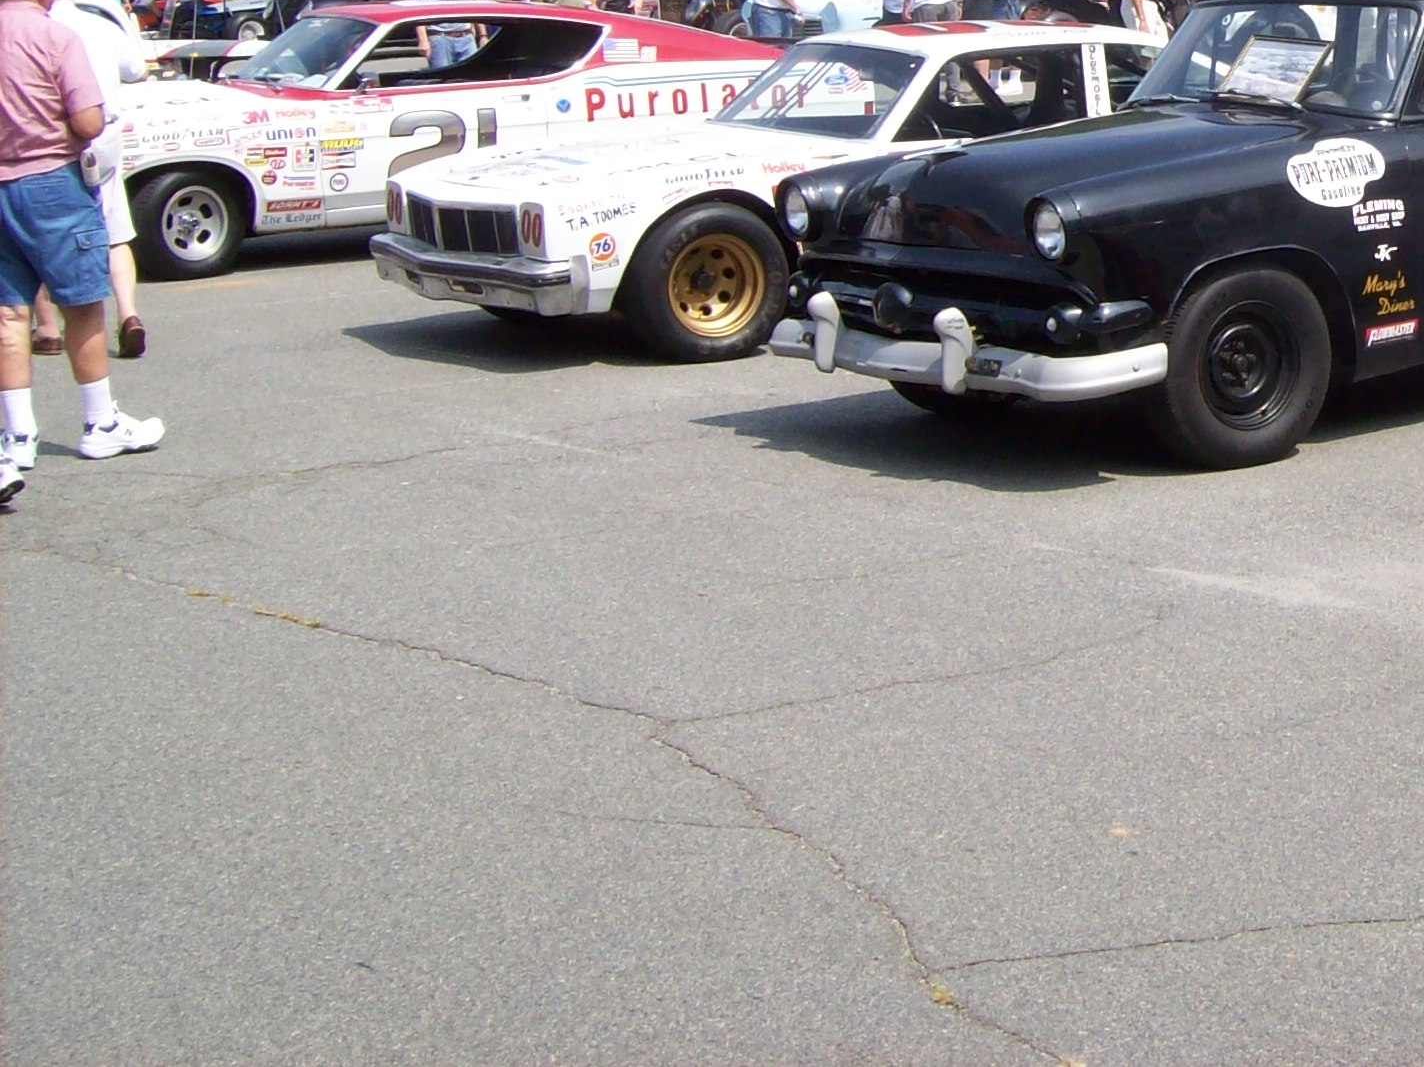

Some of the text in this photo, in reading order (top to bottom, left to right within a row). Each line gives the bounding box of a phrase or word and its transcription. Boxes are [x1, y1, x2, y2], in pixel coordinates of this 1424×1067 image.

[1088, 44, 1101, 116] OLDSMOBIL
[584, 79, 807, 122] Purolator
[242, 109, 270, 125] 3M
[1290, 153, 1378, 187] PURE-PREMIUM
[1321, 184, 1361, 201] Gasoline
[285, 212, 322, 223] Ledger
[1352, 199, 1405, 219] FLEMING
[593, 237, 612, 255] 76
[1362, 270, 1407, 297] Mary's
[1377, 296, 1416, 316] Diner
